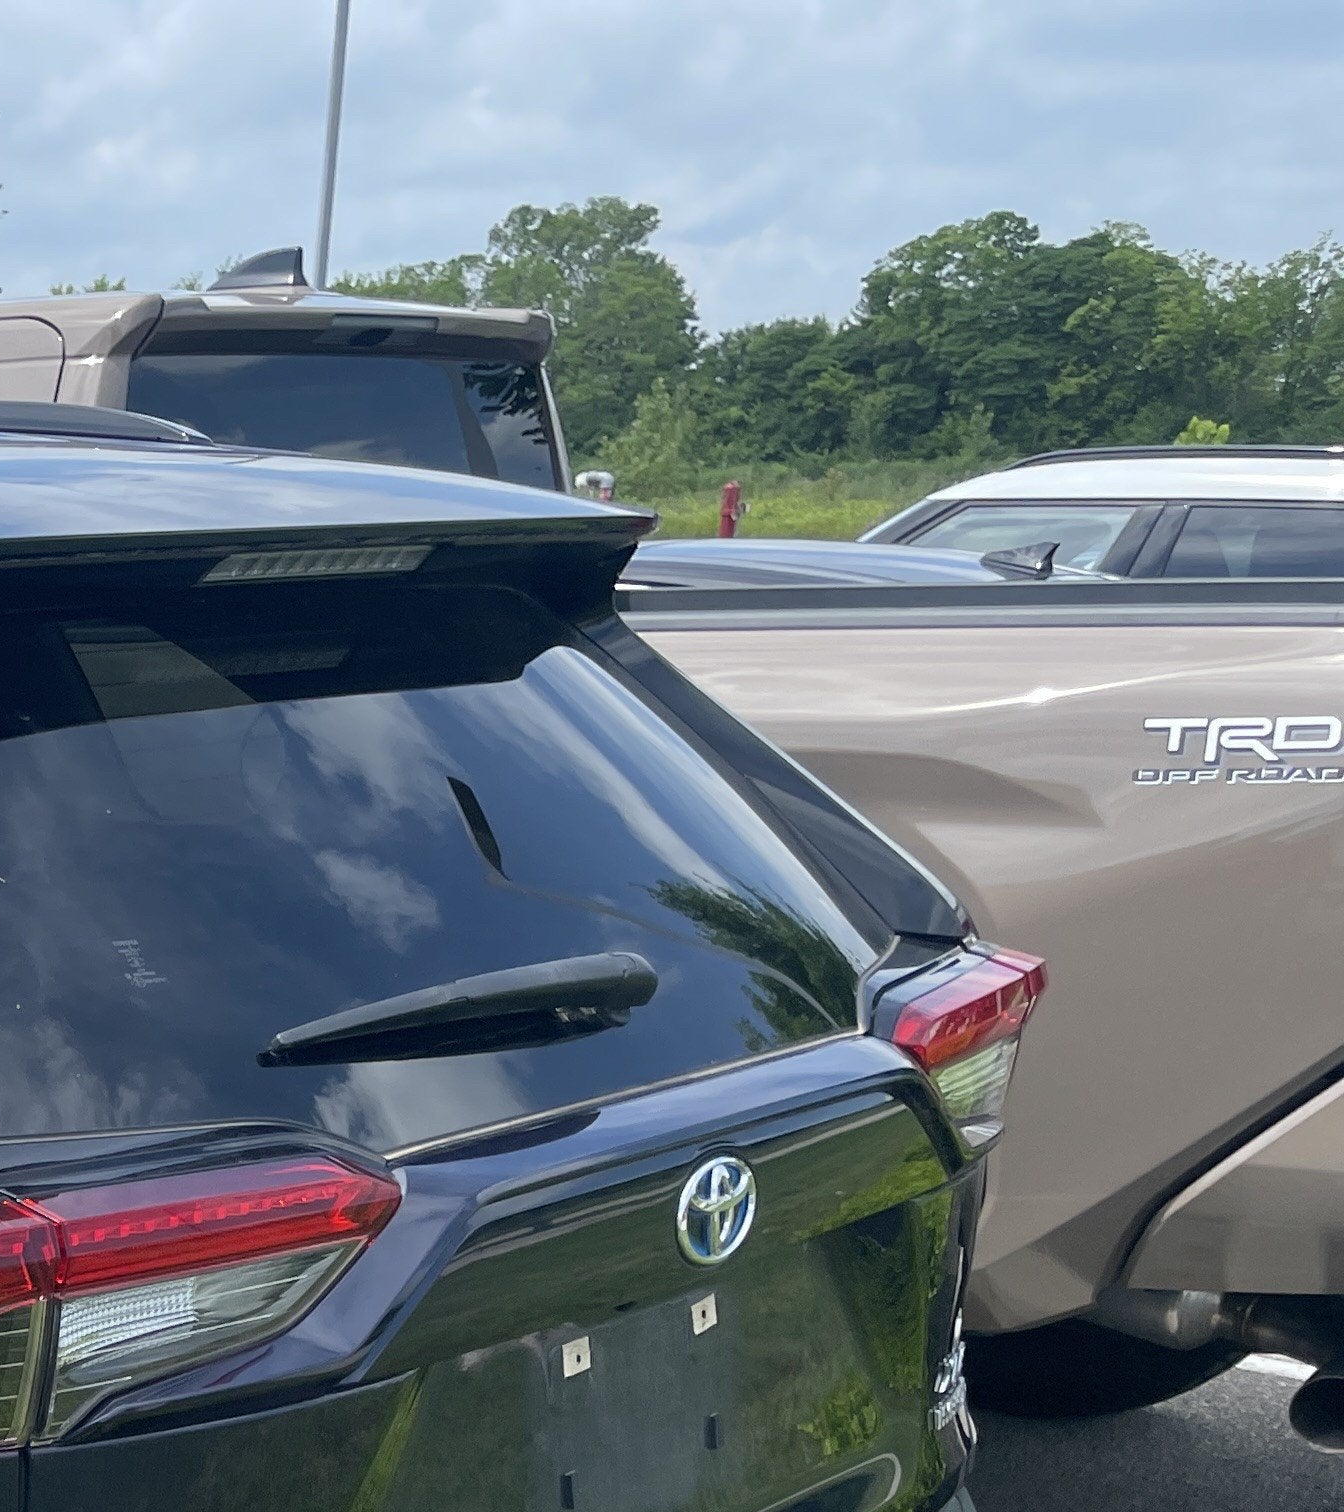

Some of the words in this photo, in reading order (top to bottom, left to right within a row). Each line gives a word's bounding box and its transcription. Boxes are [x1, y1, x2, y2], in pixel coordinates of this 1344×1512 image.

[1143, 715, 1342, 764] TRD
[1131, 768, 1220, 786] OFF
[1225, 766, 1344, 786] ROAD
